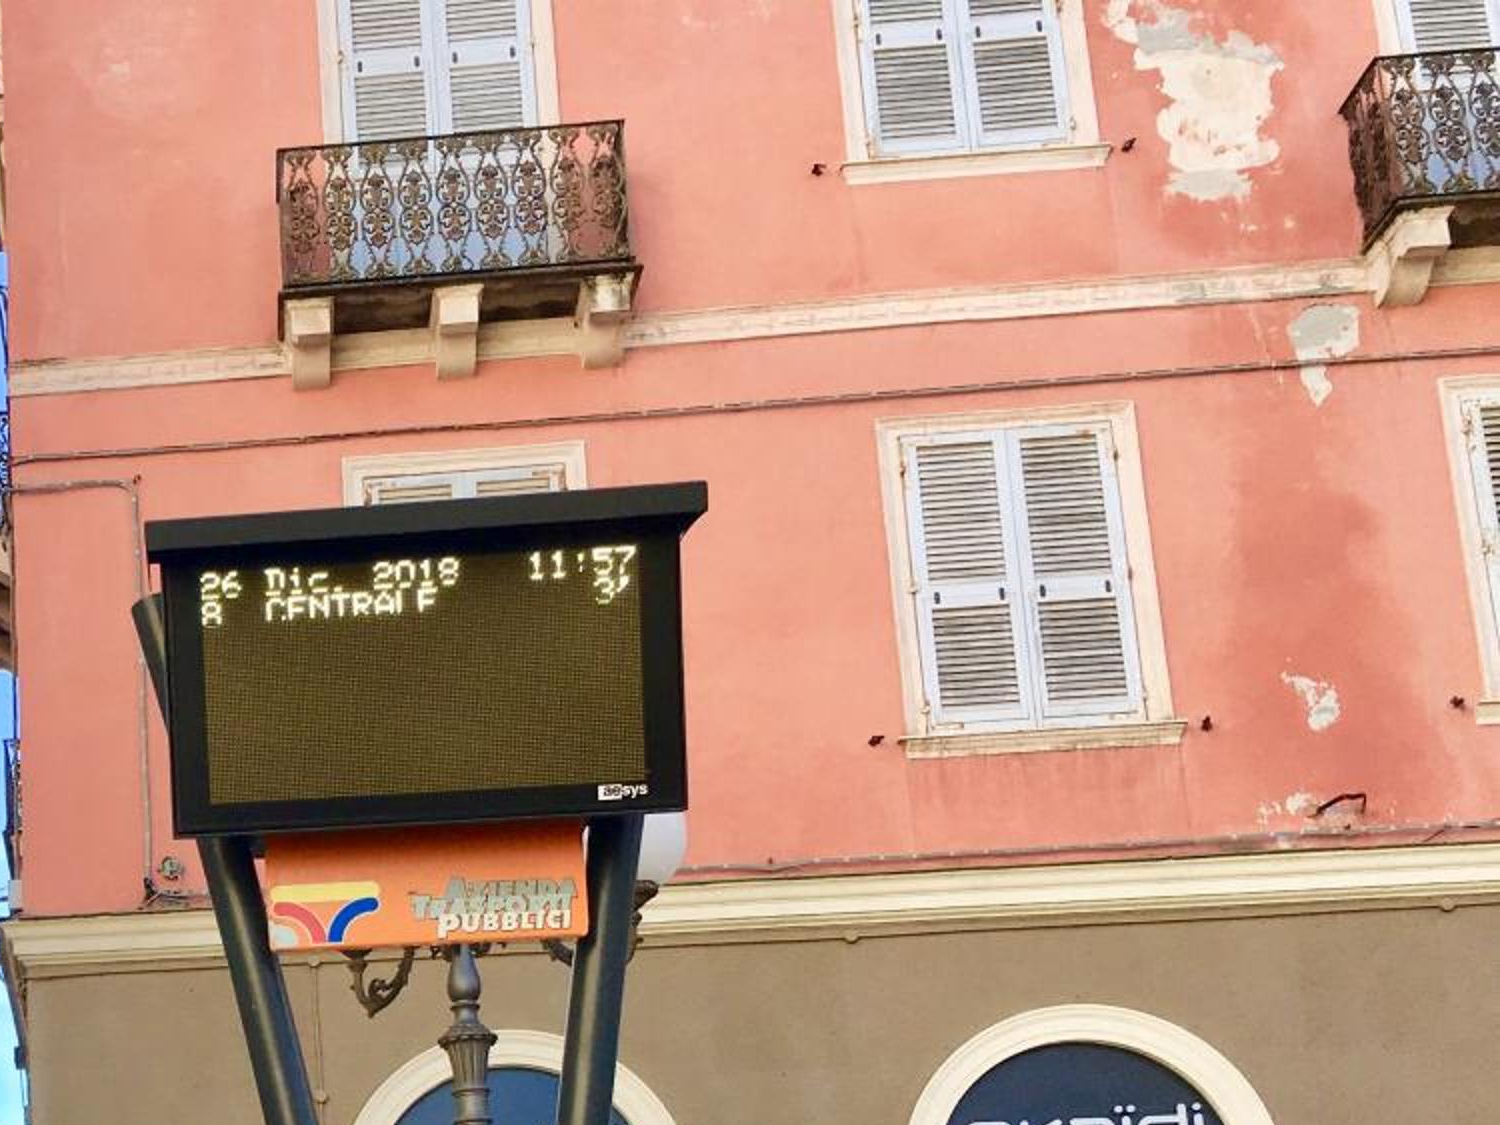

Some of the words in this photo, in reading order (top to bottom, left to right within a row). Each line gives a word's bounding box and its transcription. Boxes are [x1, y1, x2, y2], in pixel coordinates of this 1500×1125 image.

[200, 571, 242, 599] 26
[372, 556, 461, 592] 2018
[530, 545, 637, 580] 11:57
[201, 600, 223, 628] 8
